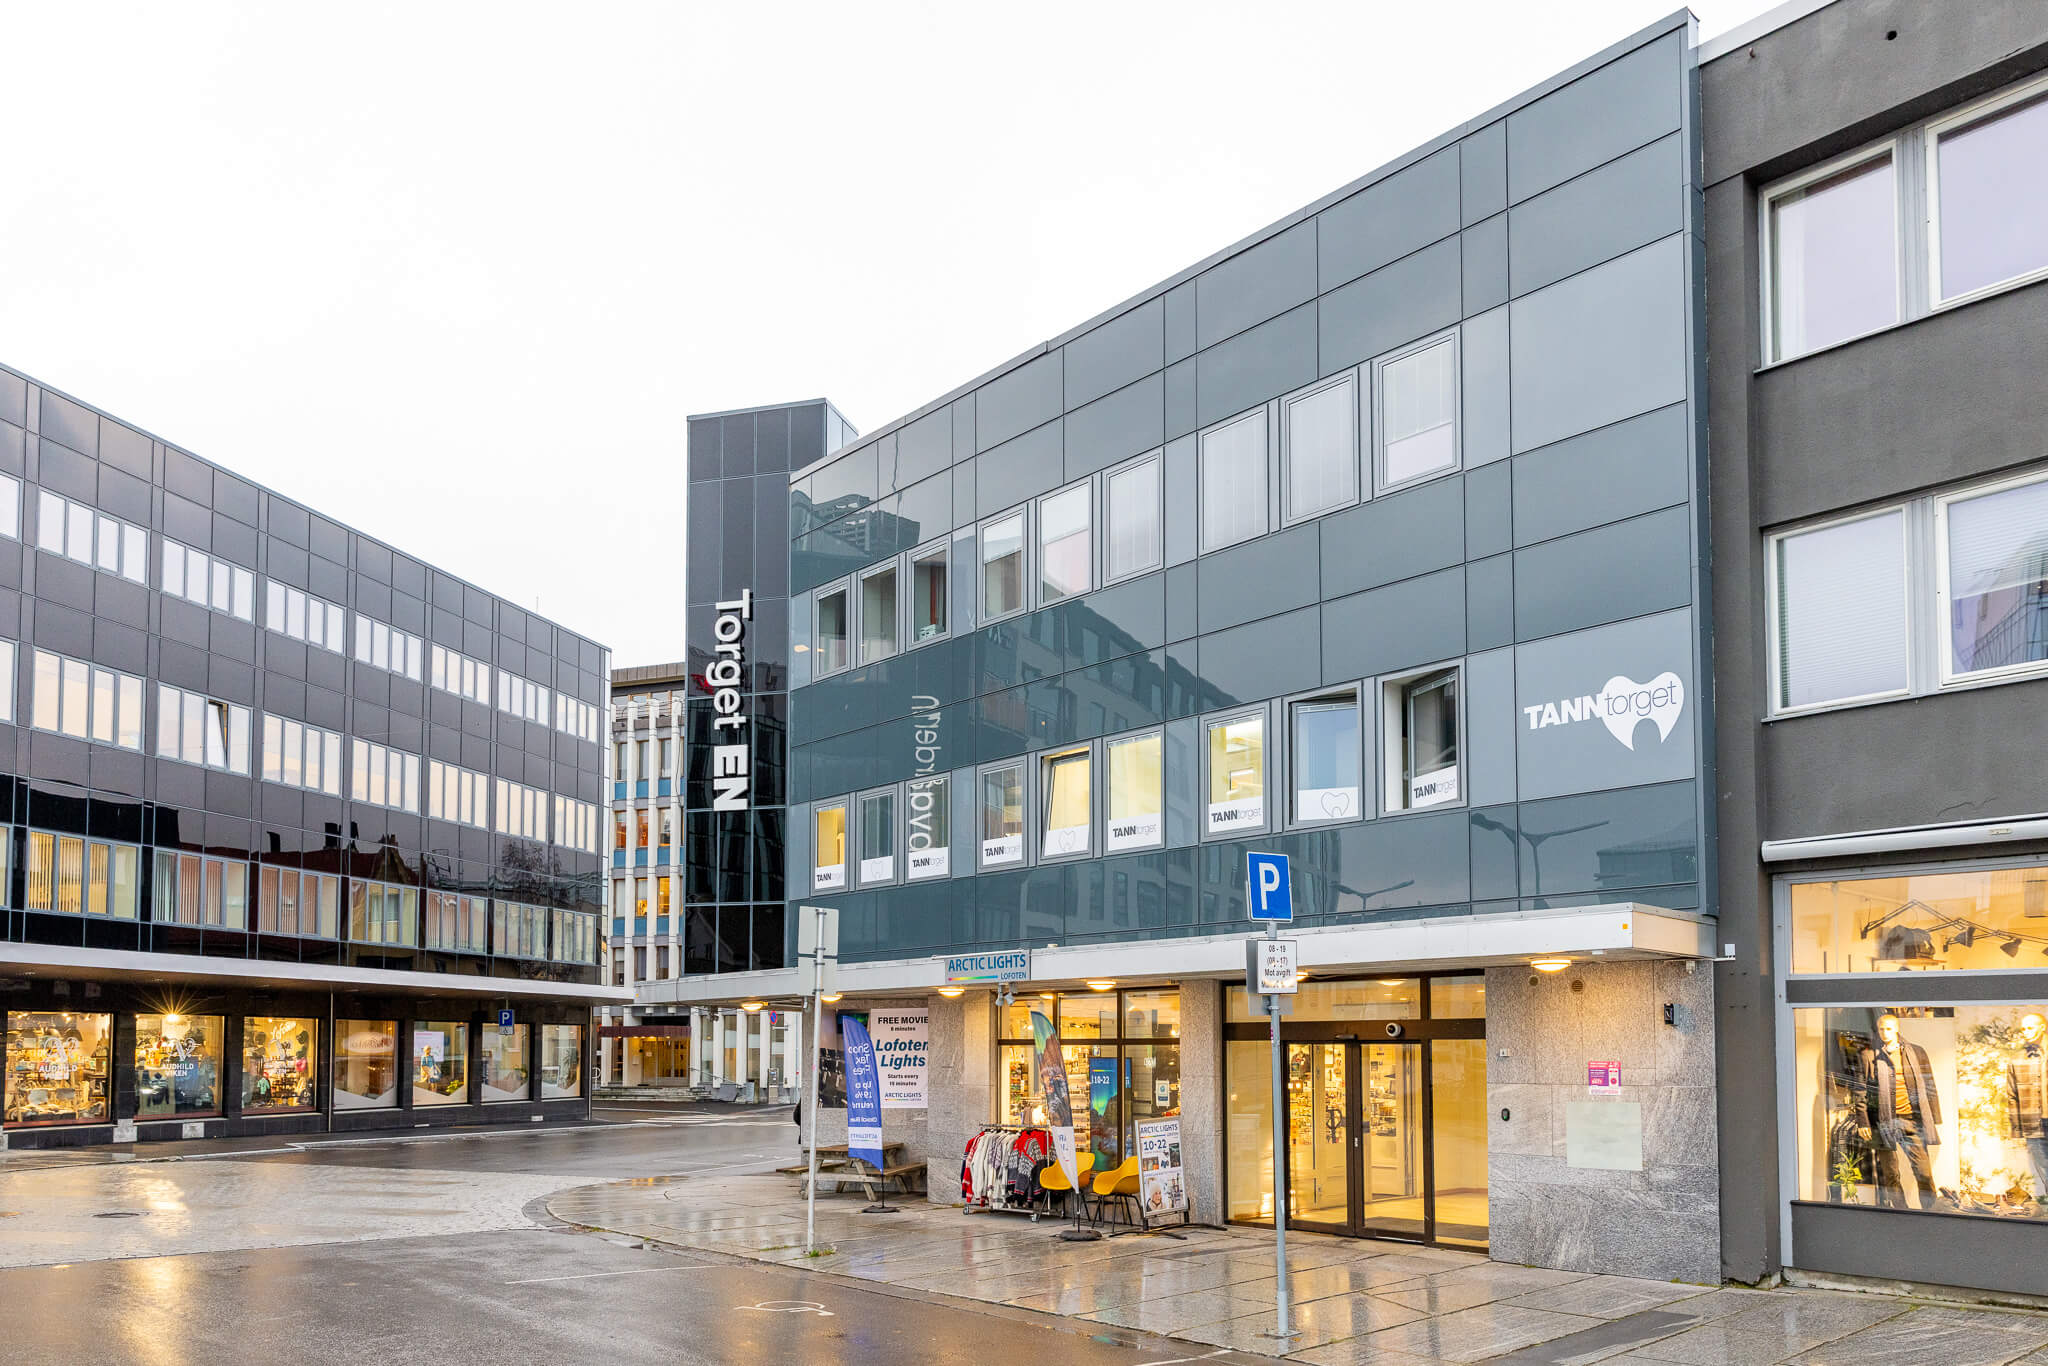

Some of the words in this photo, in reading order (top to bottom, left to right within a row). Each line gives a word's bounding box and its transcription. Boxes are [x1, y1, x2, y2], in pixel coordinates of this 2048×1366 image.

[706, 588, 750, 730] Torget
[1523, 681, 1677, 730] TANNtorget
[713, 744, 749, 811] EN
[1258, 862, 1280, 911] P
[948, 957, 985, 972] ARCTIC
[987, 953, 1026, 969] LIGHTS
[1000, 971, 1027, 980] LOFOTEN
[502, 1012, 510, 1025] P
[877, 1016, 899, 1025] FREE
[901, 1016, 928, 1024] MOVIE
[880, 1054, 926, 1070] Lights
